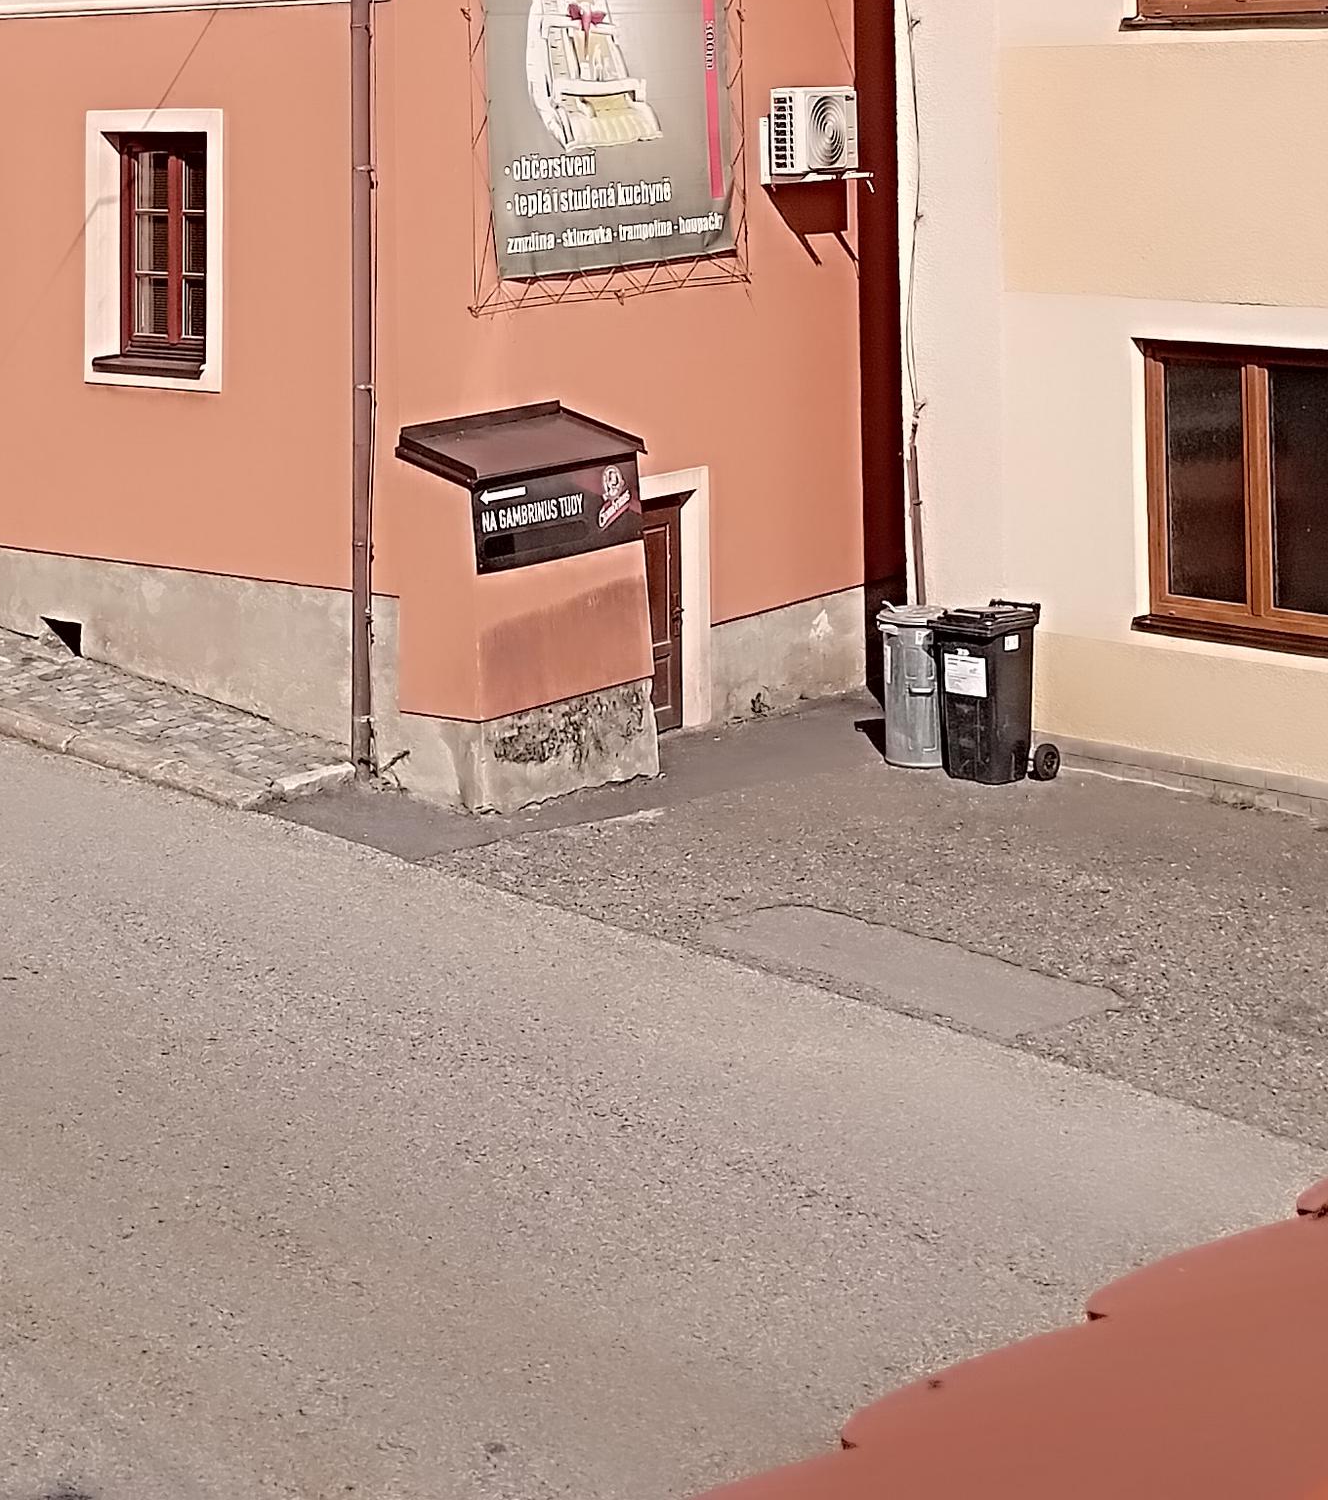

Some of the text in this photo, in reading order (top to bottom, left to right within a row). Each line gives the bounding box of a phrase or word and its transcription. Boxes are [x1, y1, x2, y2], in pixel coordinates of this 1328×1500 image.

[512, 150, 596, 181] občerstvení
[514, 177, 672, 218] teplá i studená kuchyně
[561, 225, 613, 248] skluzavka
[481, 493, 584, 533] NA GAMBRINUS TUDY
